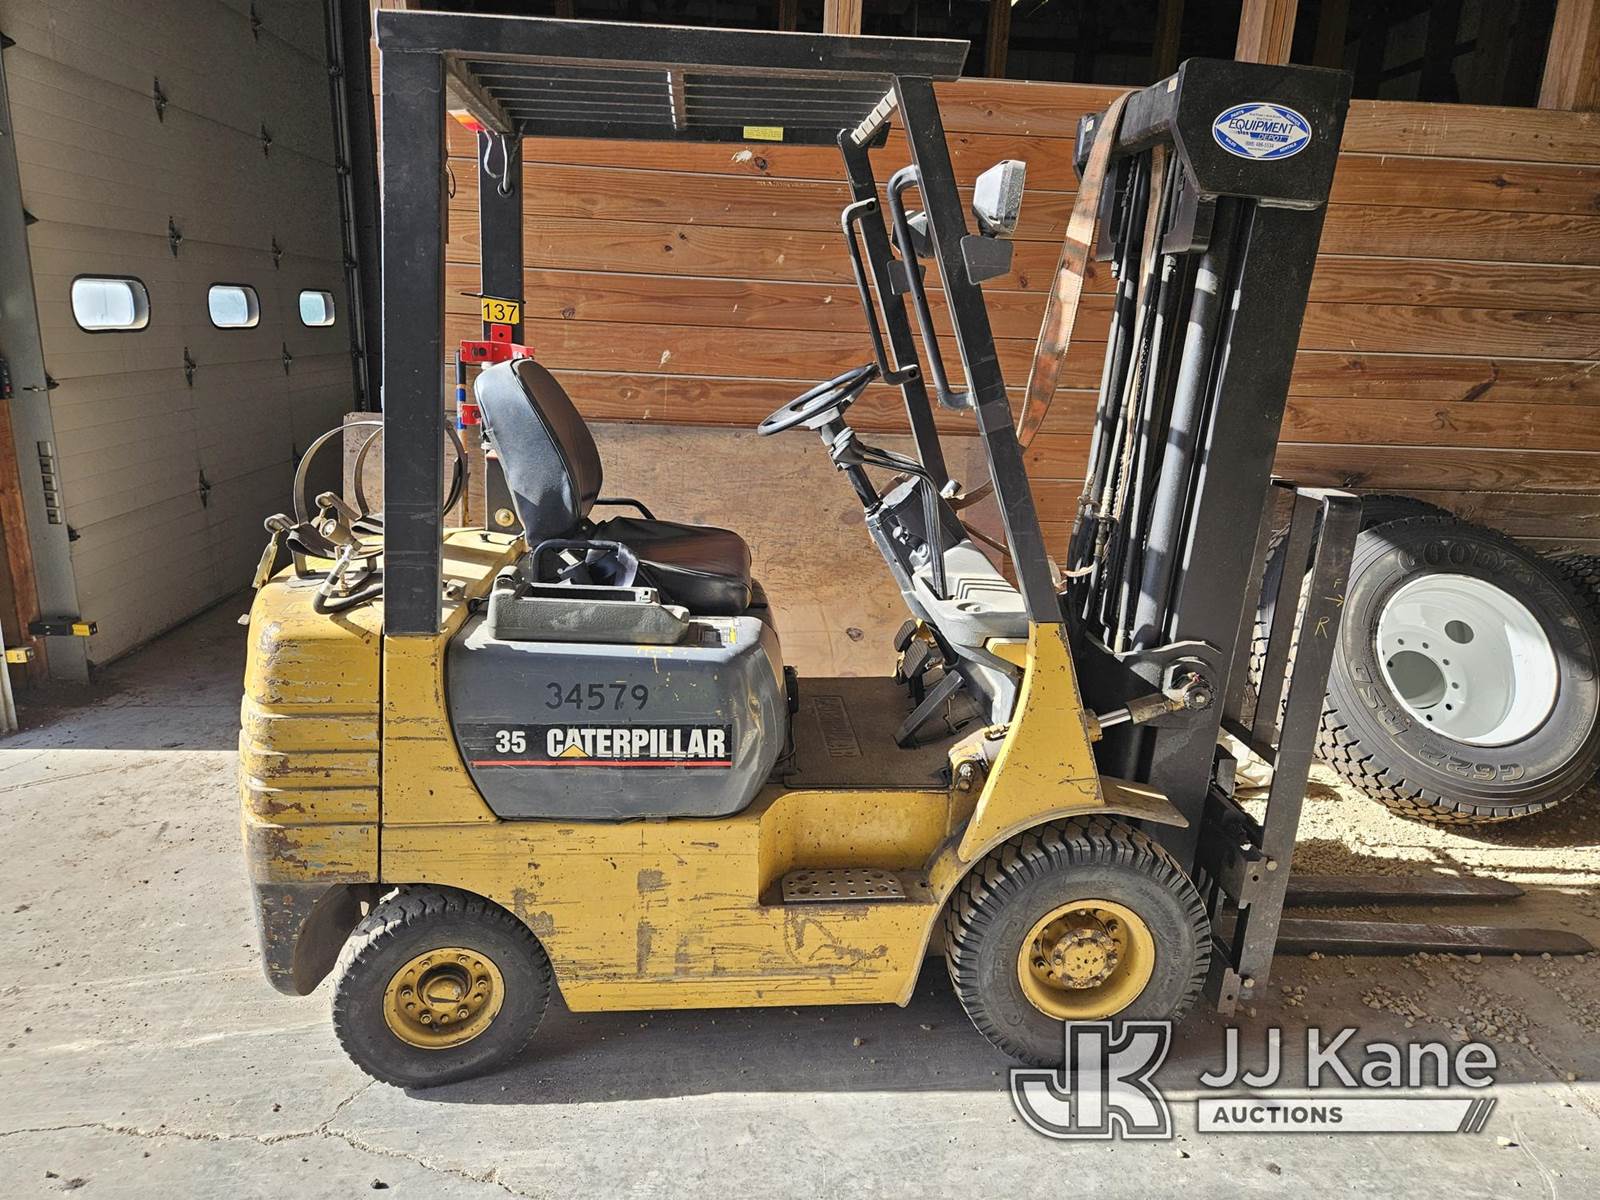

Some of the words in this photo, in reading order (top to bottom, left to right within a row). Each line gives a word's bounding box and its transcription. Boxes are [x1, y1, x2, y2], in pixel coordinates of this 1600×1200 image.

[1228, 118, 1294, 134] EQUIPMENT
[1258, 133, 1284, 141] DEPOT
[483, 303, 517, 321] 137
[544, 682, 649, 711] 34579
[495, 730, 526, 753] 35
[546, 728, 726, 758] CATERPILLAR
[1418, 743, 1526, 782] G622
